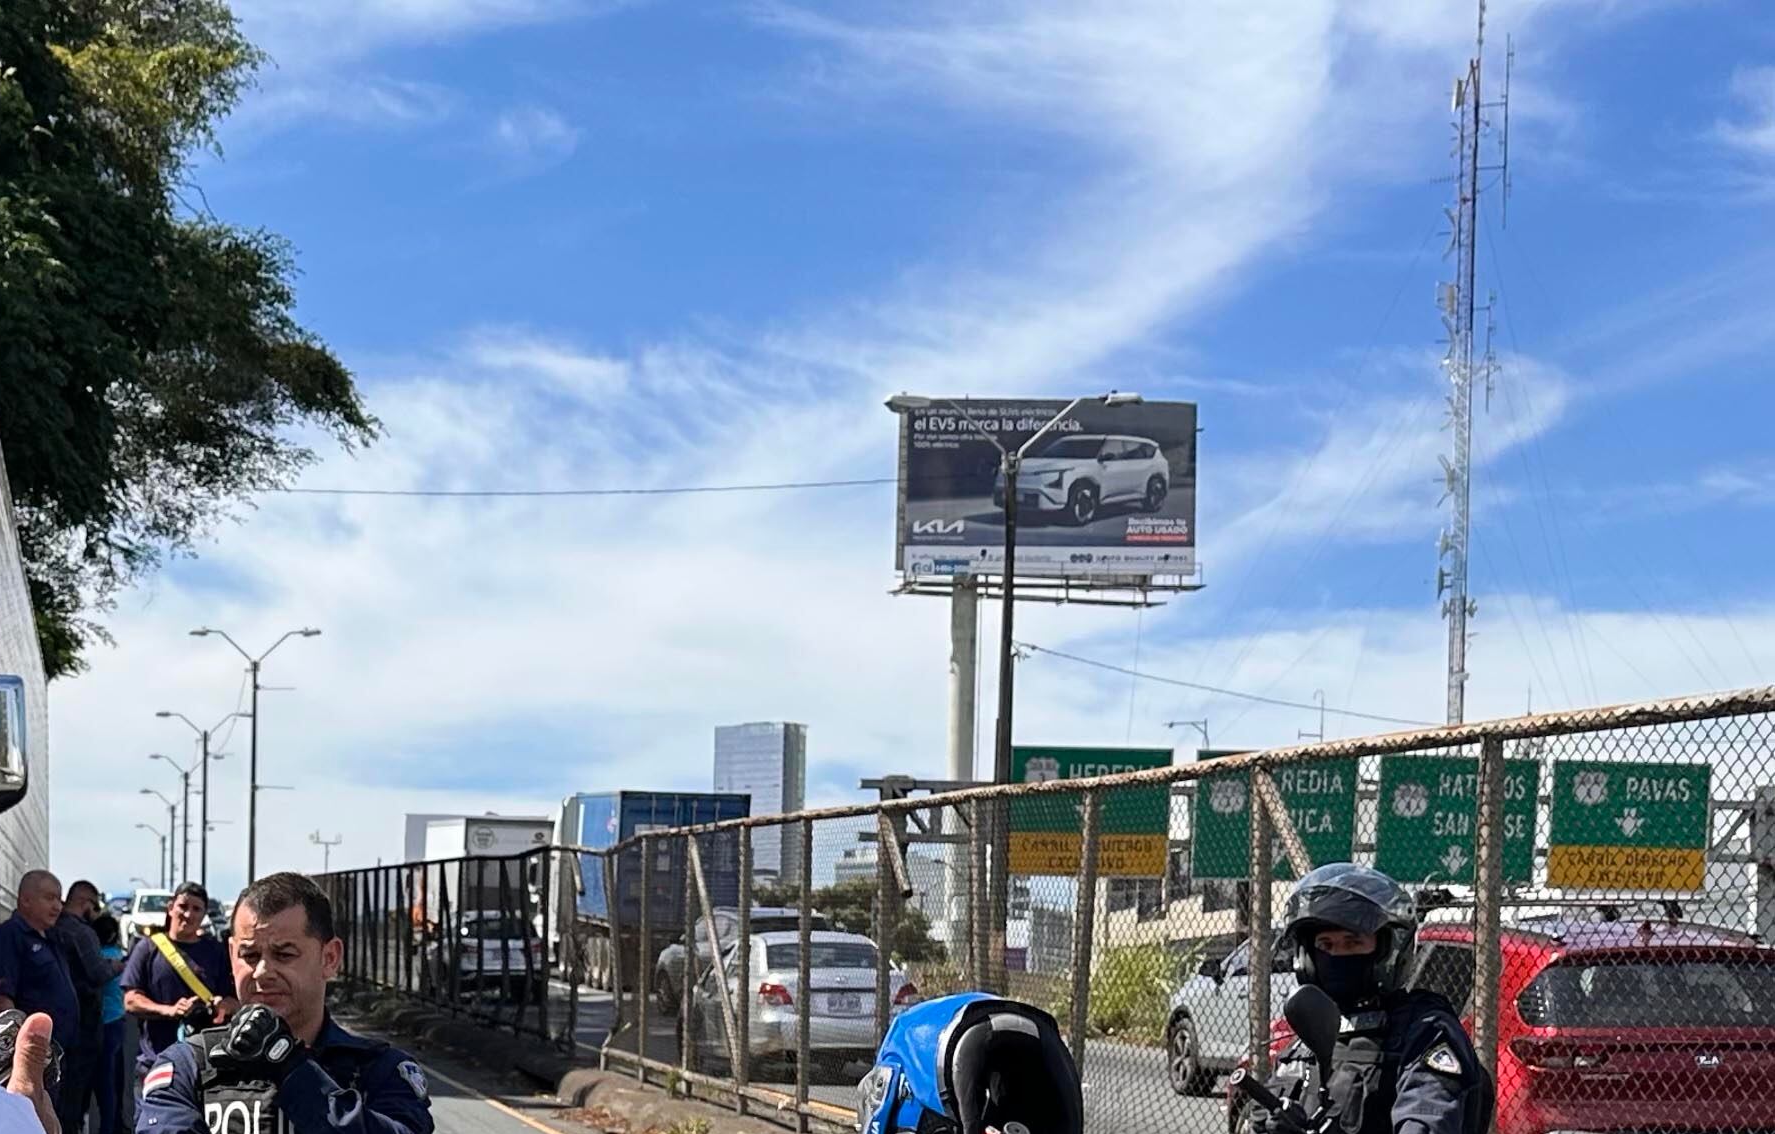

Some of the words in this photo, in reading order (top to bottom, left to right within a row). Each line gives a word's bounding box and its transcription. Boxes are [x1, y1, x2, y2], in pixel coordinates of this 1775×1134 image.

[914, 417, 925, 431] el
[929, 417, 955, 431] EV5
[1002, 417, 1013, 431] la
[912, 518, 965, 534] KIA
[1273, 769, 1344, 794] REDIA
[1625, 776, 1691, 802] PAVAS
[1433, 811, 1469, 837] SAN
